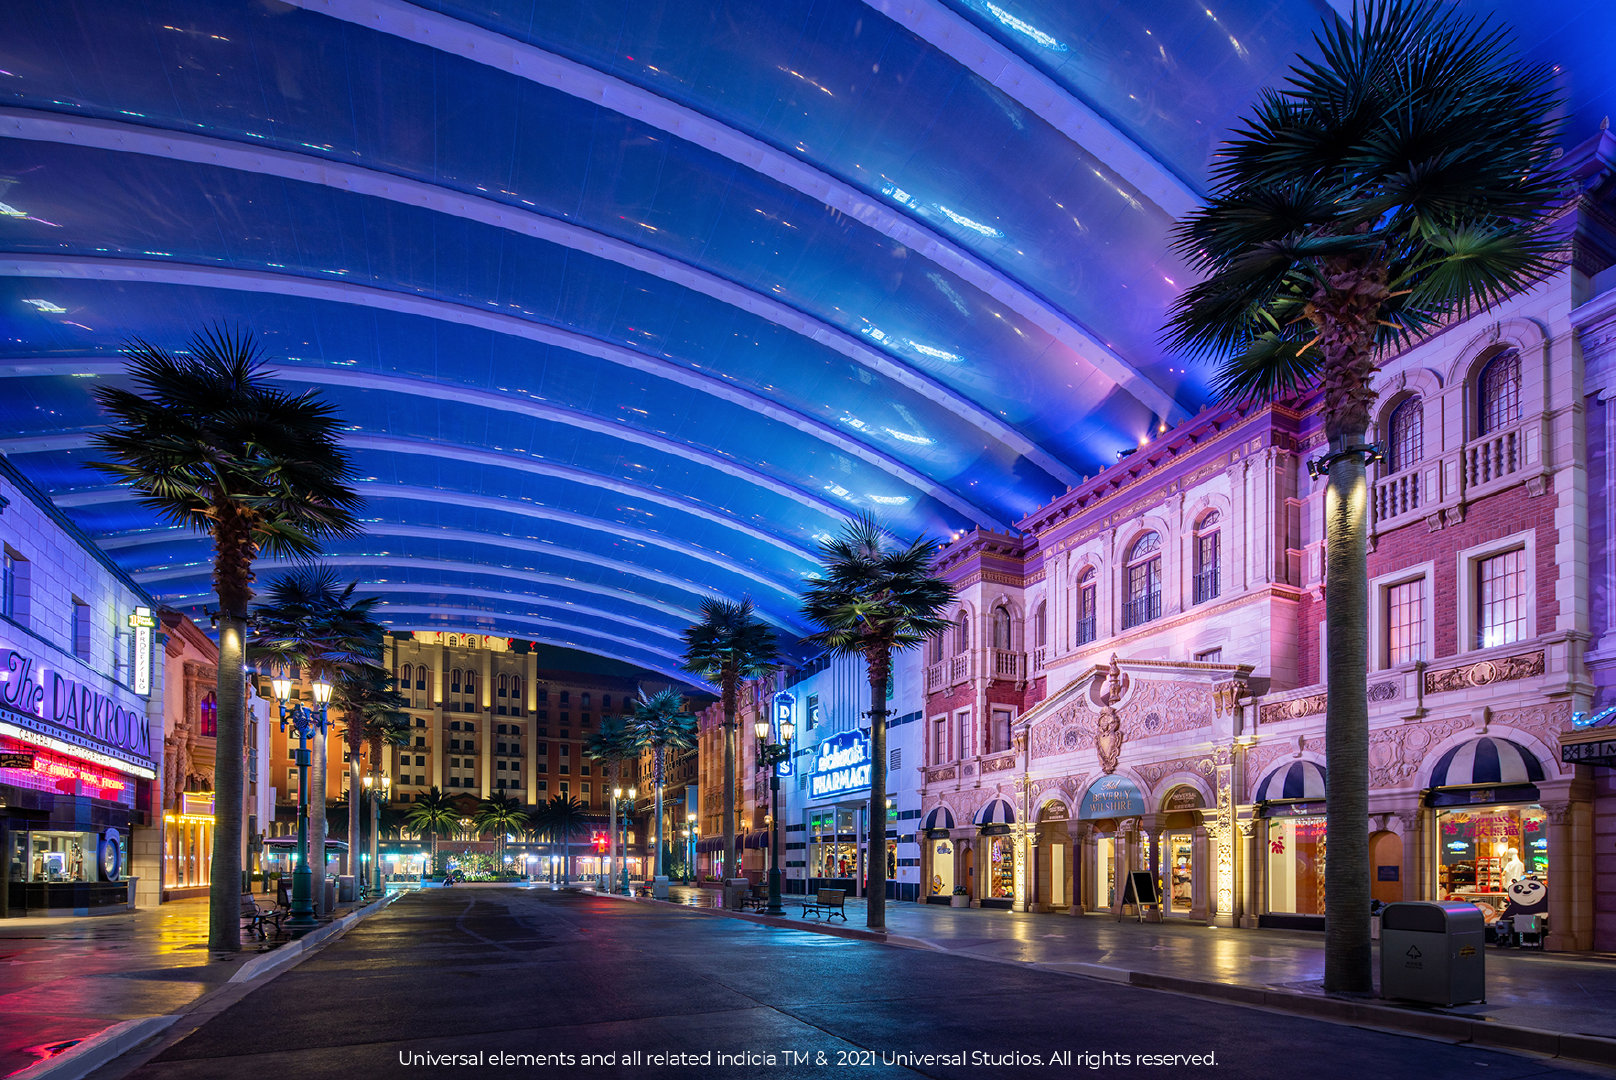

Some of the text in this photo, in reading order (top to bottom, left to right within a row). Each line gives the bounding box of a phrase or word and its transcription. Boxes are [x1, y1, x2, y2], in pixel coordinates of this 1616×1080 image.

[4, 650, 152, 758] The DARKROOM
[812, 764, 872, 795] PHARMACY
[1090, 801, 1133, 812] WILSHIRE
[1093, 789, 1131, 802] BEVERLY
